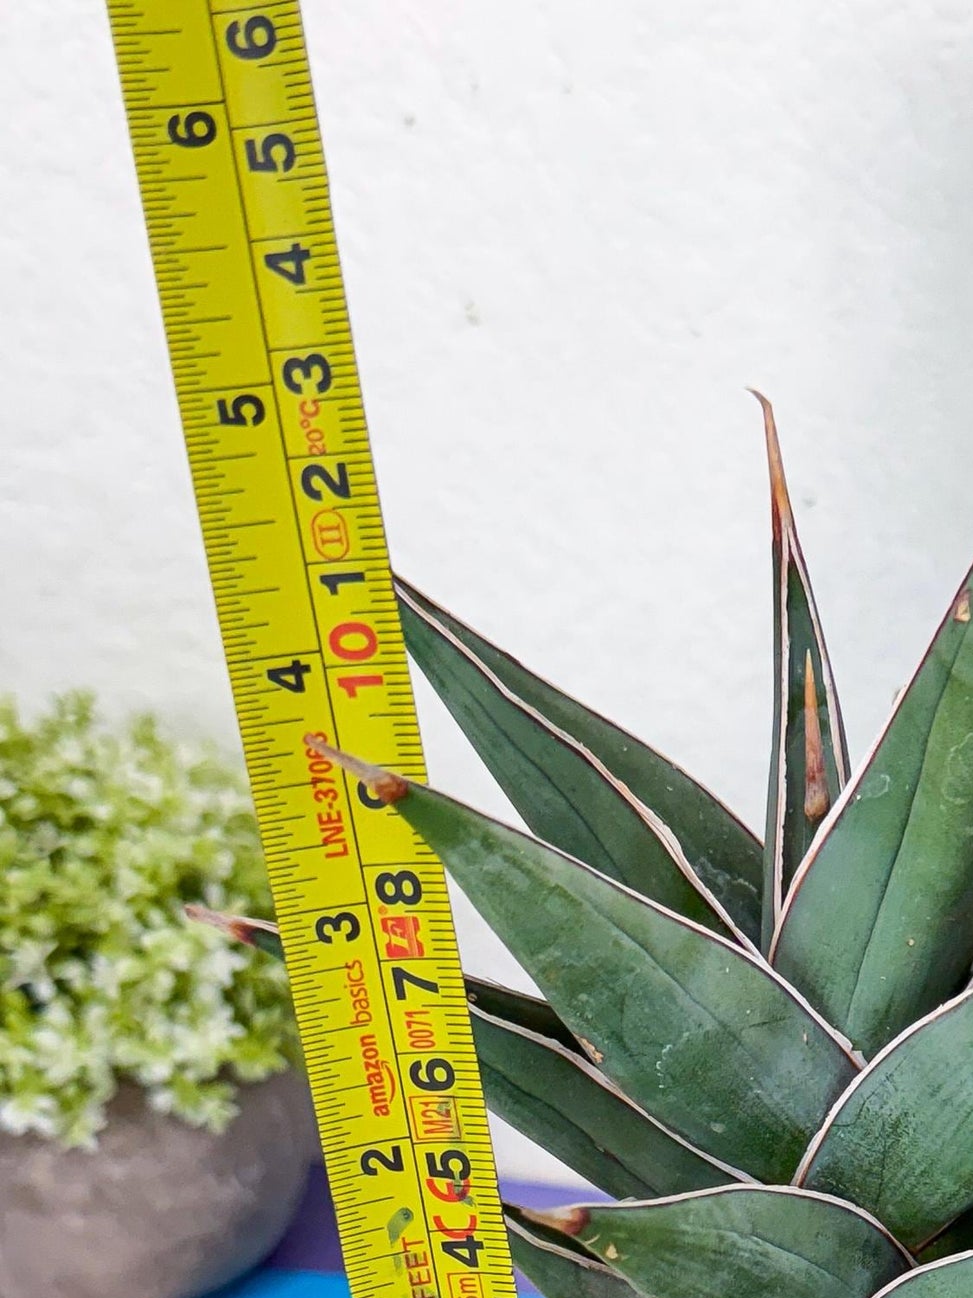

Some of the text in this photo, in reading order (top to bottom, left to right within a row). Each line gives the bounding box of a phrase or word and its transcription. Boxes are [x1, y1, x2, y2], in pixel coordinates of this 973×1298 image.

[225, 15, 277, 60] 6
[168, 111, 217, 148] 6
[245, 133, 297, 173] 5
[264, 243, 312, 285] 4
[282, 354, 332, 395] 3
[217, 394, 266, 427] 5
[302, 463, 352, 501] 2
[320, 572, 366, 596] 1
[267, 660, 311, 693] 4
[329, 622, 384, 699] 10
[375, 870, 422, 905] 8
[315, 912, 361, 944] 3
[391, 967, 440, 1000] 7
[343, 959, 391, 1117] amazon basics
[404, 1010, 436, 1049] 0071
[409, 1058, 456, 1091] 6
[361, 1145, 405, 1176] 2
[425, 1150, 471, 1180] 5
[441, 1235, 485, 1268] 4
